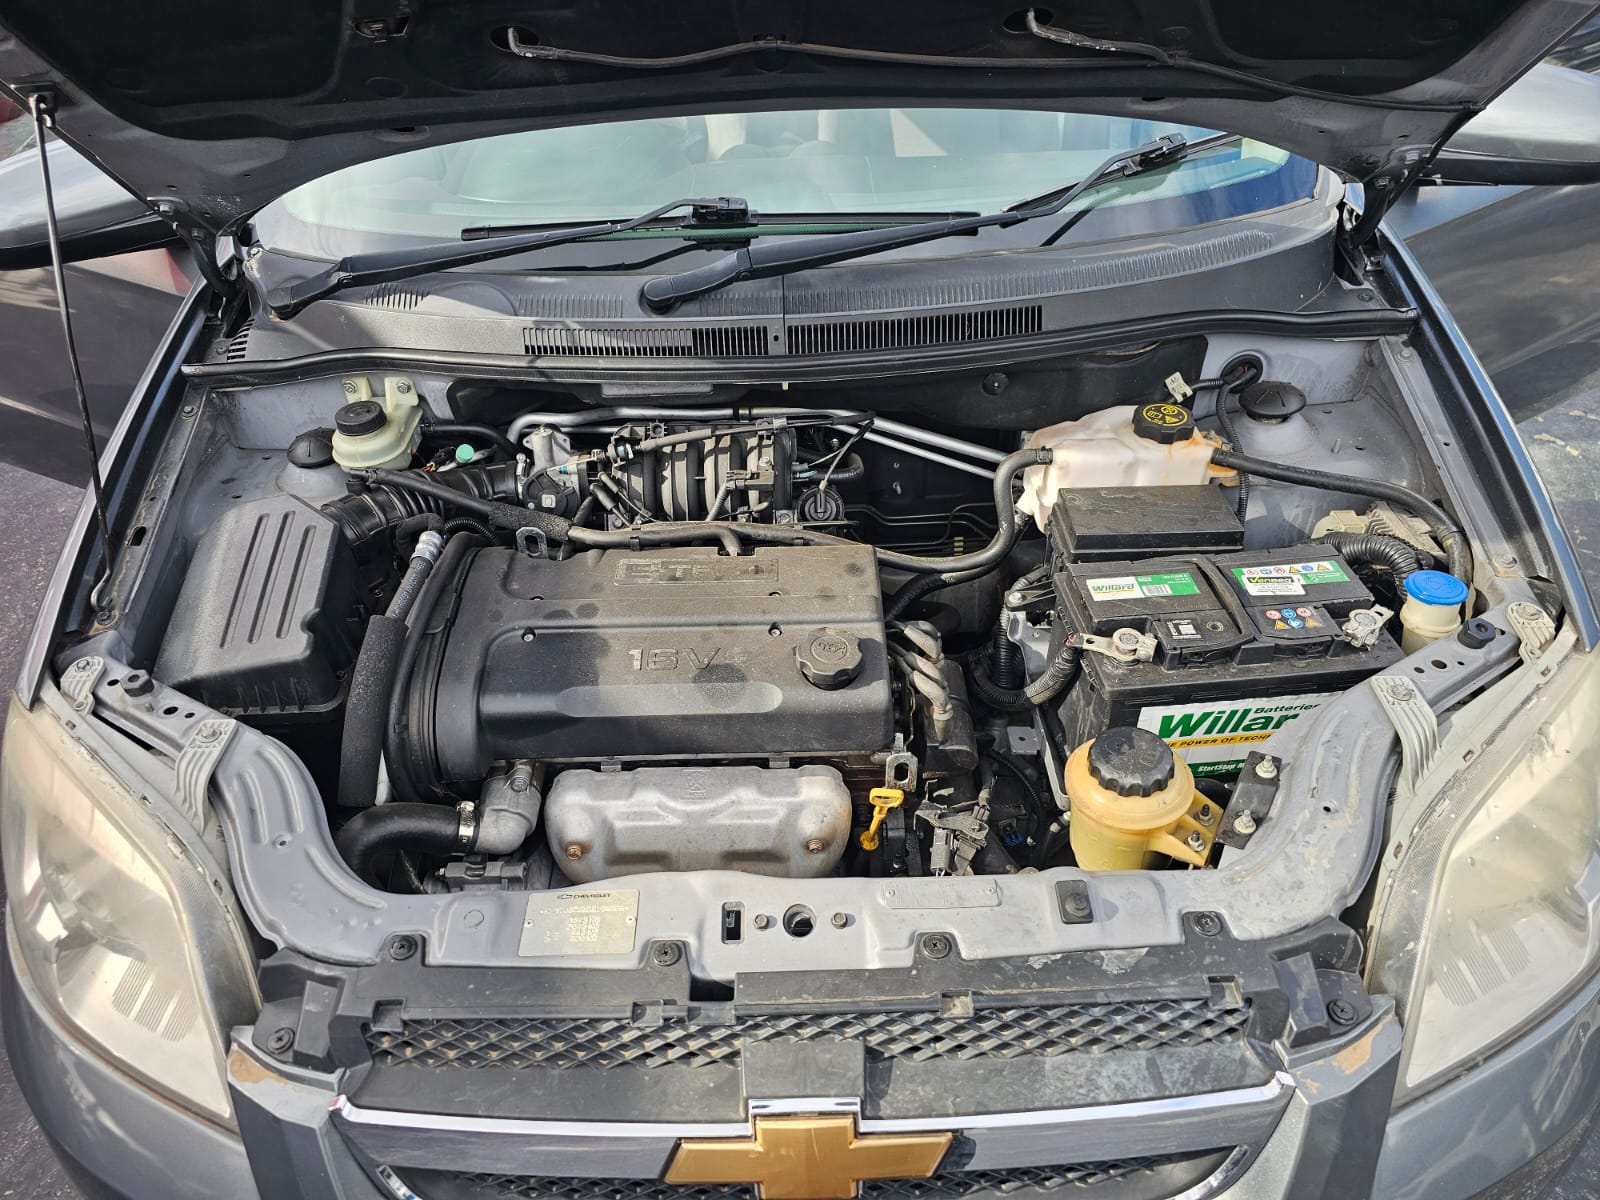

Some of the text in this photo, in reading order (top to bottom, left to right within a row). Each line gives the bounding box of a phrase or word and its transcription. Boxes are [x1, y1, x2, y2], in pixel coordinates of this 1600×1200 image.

[1092, 583, 1135, 592] Willard
[627, 647, 721, 671] 16V
[1158, 708, 1300, 739] Willar
[1180, 738, 1218, 746] POWER
[1197, 763, 1236, 772] StartStop
